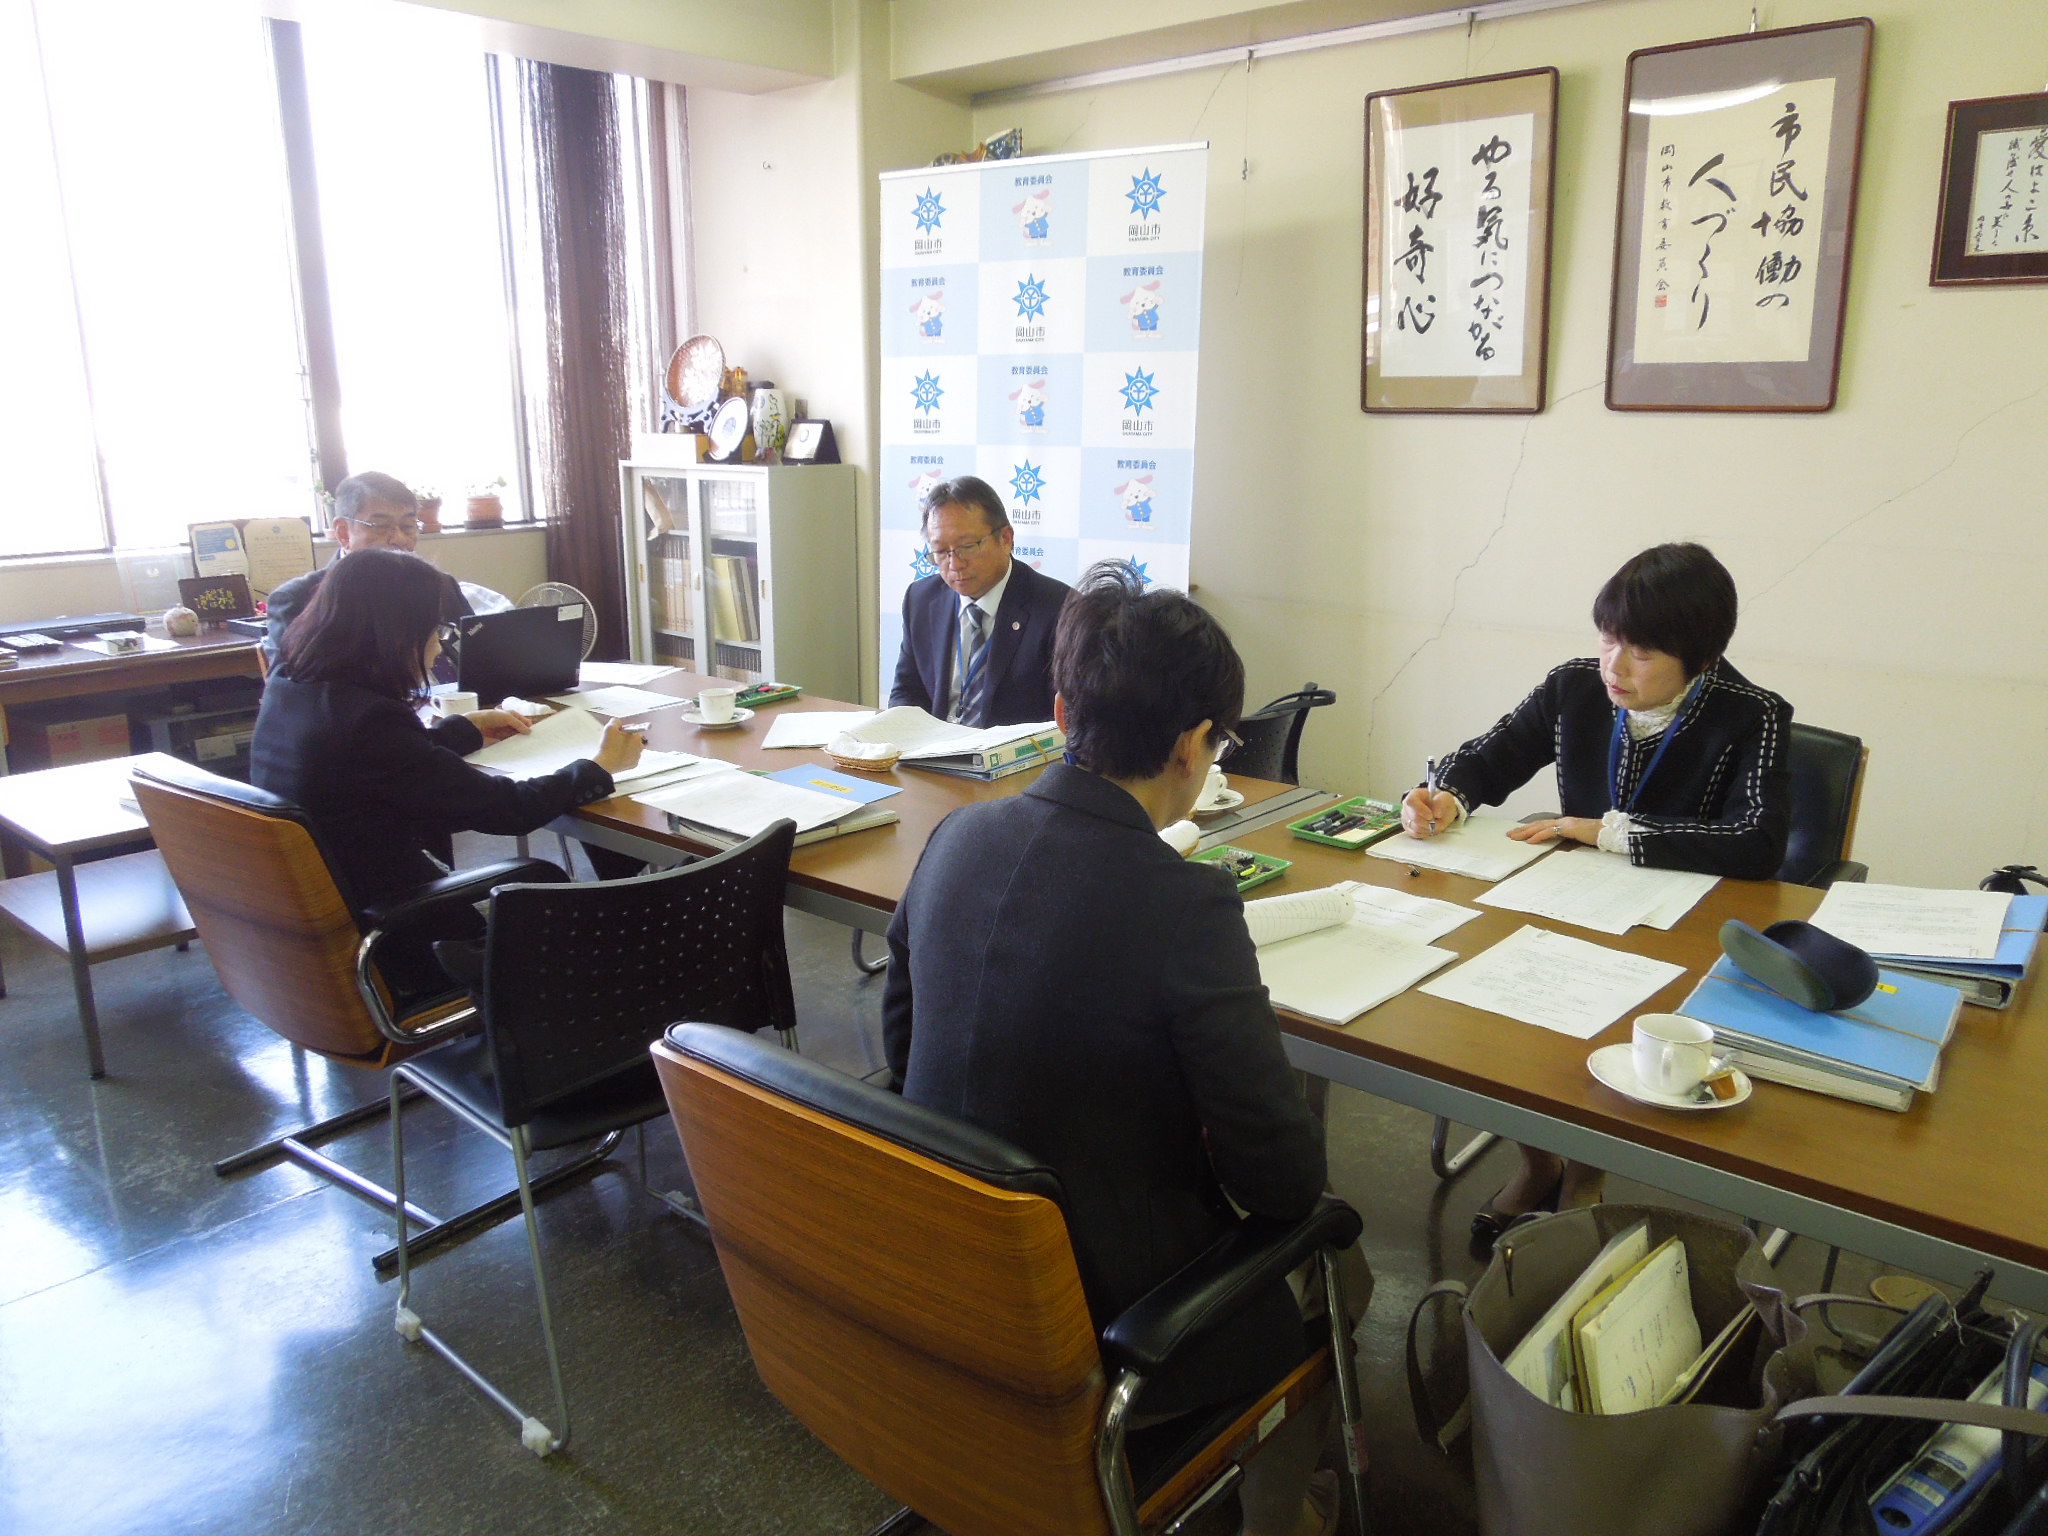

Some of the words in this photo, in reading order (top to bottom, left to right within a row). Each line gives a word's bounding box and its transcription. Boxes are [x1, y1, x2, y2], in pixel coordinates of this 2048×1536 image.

[1014, 174, 1053, 187] 教育委員会
[1128, 223, 1161, 237] 岡山市
[914, 238, 942, 250] 岡山市
[1687, 152, 1737, 330] 人づくり
[1393, 166, 1444, 335] 好奇心
[1467, 134, 1512, 361] やる気につながる
[1123, 265, 1164, 277] 教育委員会
[911, 276, 946, 287] 教育委員会
[1015, 326, 1045, 338] 岡山市
[1011, 365, 1049, 376] 教育委員会
[913, 418, 941, 429] 岡山市
[1122, 419, 1154, 431] 岡山市
[910, 455, 944, 465] 教育委員会
[1117, 459, 1157, 470] 教育委員会
[1012, 509, 1041, 520] 岡山市
[1012, 546, 1044, 557] 育委員会
